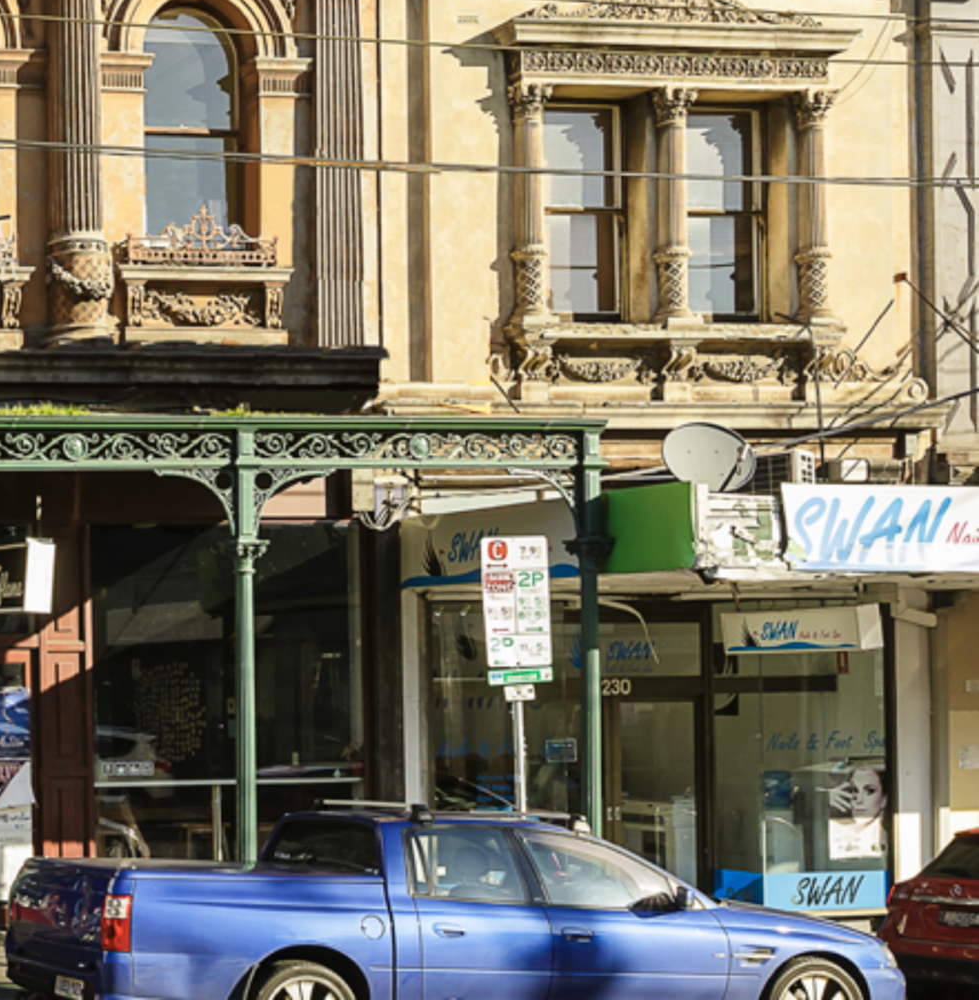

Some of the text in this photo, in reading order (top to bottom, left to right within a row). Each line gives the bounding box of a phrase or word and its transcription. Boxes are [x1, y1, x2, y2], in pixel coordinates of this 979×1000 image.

[794, 495, 953, 564] SWAN
[518, 571, 544, 587] 2P
[761, 620, 798, 640] SWAN
[606, 640, 655, 660] SWAN
[601, 679, 631, 696] 230
[793, 874, 865, 907] SWAN
